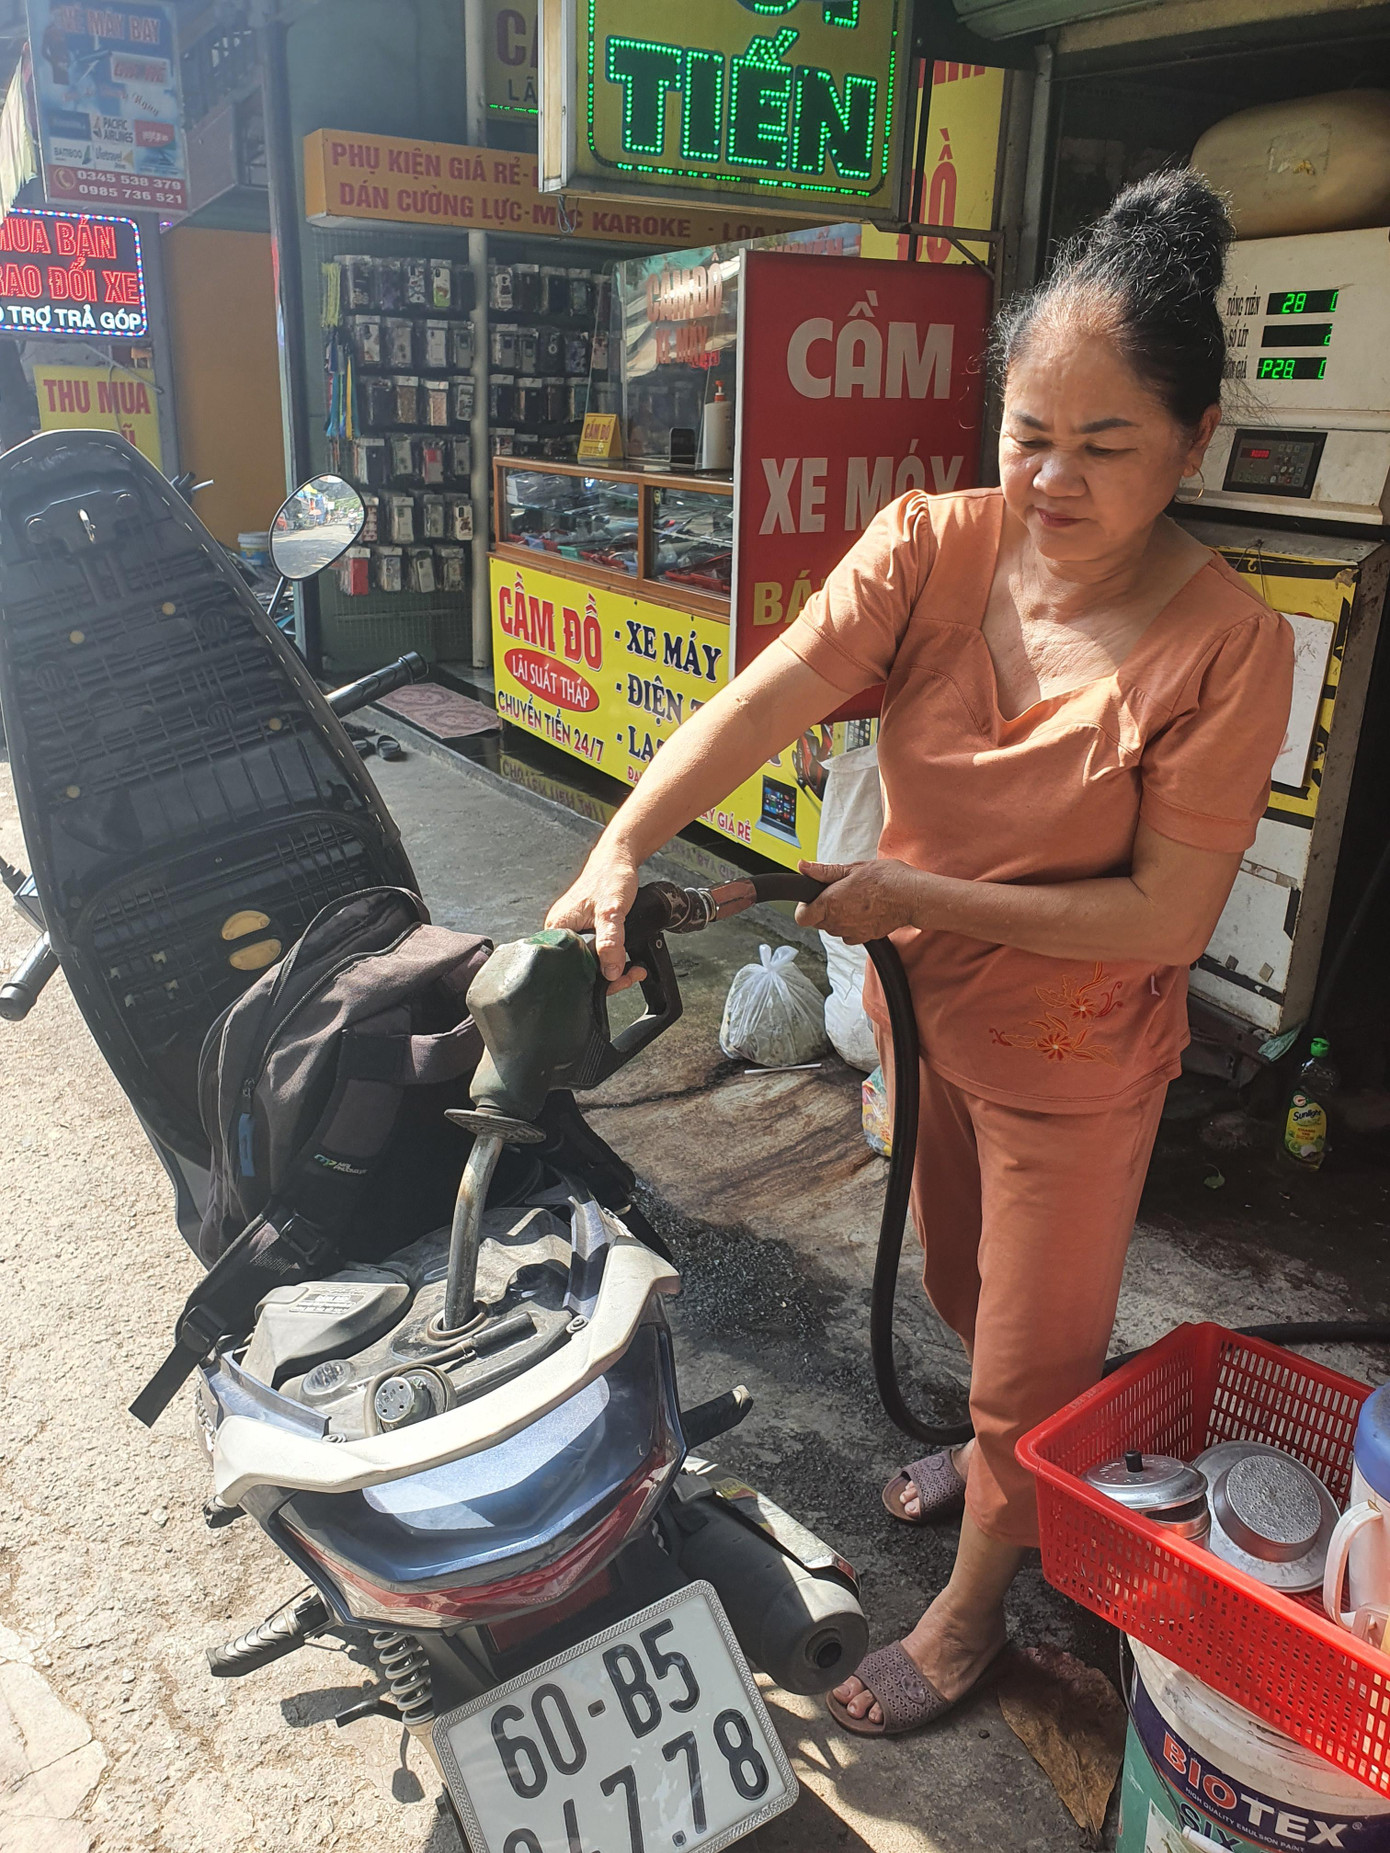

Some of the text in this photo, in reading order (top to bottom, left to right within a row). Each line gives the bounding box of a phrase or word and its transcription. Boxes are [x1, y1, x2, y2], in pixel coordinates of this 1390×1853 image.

[605, 26, 877, 180] TIẾN
[332, 143, 380, 174] PHỤ
[388, 148, 441, 180] KIỆN
[450, 155, 486, 182] GIÁ
[156, 192, 182, 204] 521
[340, 179, 388, 210] DÁN
[397, 185, 473, 218] CƯỜNG
[593, 211, 691, 238] KAROKE
[55, 217, 117, 259] BÁN
[48, 252, 97, 302] ĐỔI
[102, 270, 140, 305] XE
[7, 304, 51, 332] TRỢ
[54, 304, 96, 328] TRẢ
[100, 308, 143, 331] GÓP
[787, 290, 954, 399] CẦM
[43, 379, 151, 415] THU MUA
[758, 457, 828, 535] XE
[499, 571, 603, 671] CẦM ĐỒ
[626, 620, 722, 683] XE MÁY
[512, 654, 590, 708] LÃI SUẤT THẤP
[627, 673, 684, 726] ĐIỆN
[498, 693, 542, 731] CHUYỂN
[574, 728, 604, 763] 24/7
[717, 811, 735, 836] GIÁ
[737, 819, 752, 843] RẺ
[1293, 1109, 1321, 1121] Sunlight
[491, 1618, 700, 1800] 60-B5
[1163, 1731, 1348, 1849] BIOTEX
[1185, 1787, 1202, 1804] HIGH
[1203, 1802, 1235, 1825] QUALITY
[1236, 1822, 1279, 1848] EMULSION
